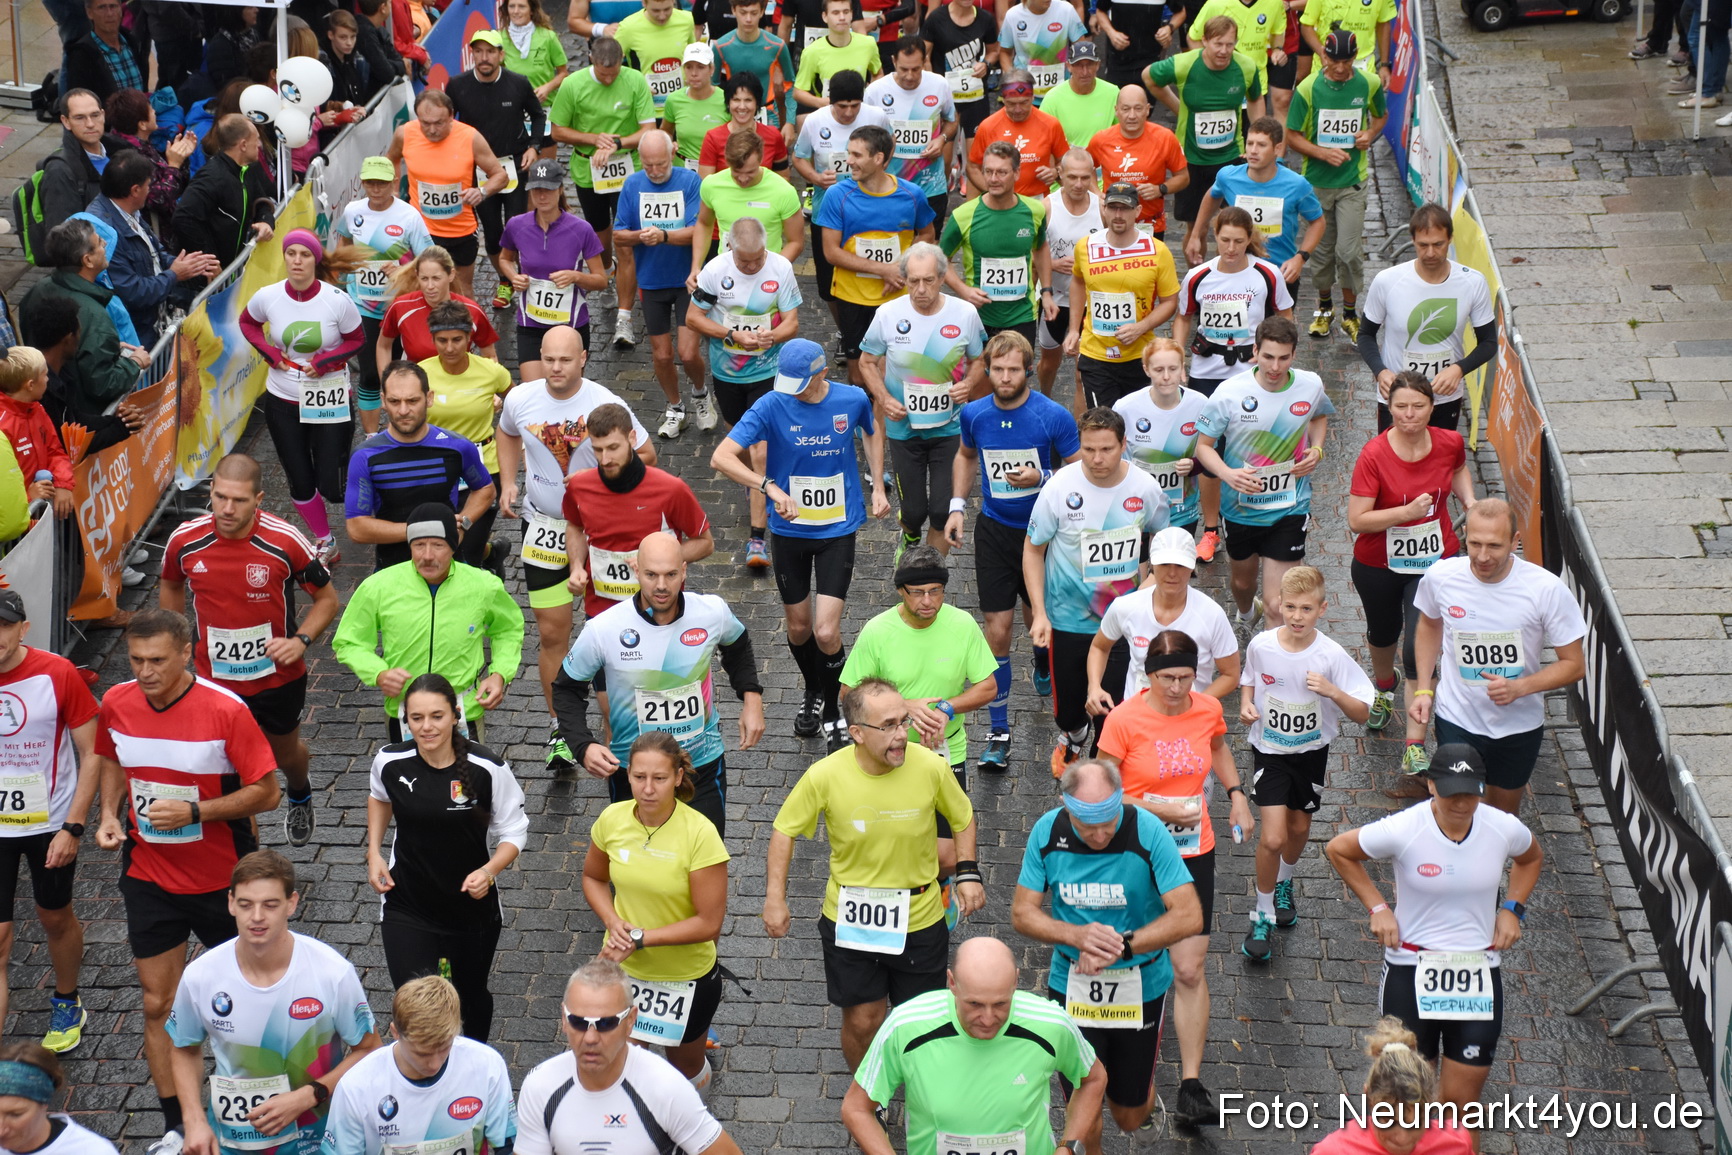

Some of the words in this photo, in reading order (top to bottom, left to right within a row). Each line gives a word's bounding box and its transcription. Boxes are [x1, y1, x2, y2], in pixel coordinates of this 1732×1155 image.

[654, 60, 680, 73] Hervis
[651, 77, 682, 95] 3099
[961, 78, 969, 91] 5
[1035, 73, 1058, 87] 198
[1200, 119, 1233, 135] 2753
[1322, 118, 1358, 134] 2456
[894, 129, 928, 144] 2805
[1206, 135, 1228, 145] Gerhard
[1330, 135, 1348, 144] Albert
[899, 146, 921, 154] Homaid
[601, 162, 627, 179] 205
[422, 191, 459, 207] 2646
[429, 207, 454, 216] Michael
[644, 202, 680, 219] 2471
[1254, 207, 1263, 223] 3
[864, 248, 893, 264] 286
[1089, 264, 1119, 277] MAX
[1123, 259, 1158, 271] BÖGL
[986, 268, 1024, 285] 2317
[535, 290, 564, 309] 167
[992, 288, 1017, 296] Thomas
[535, 309, 558, 320] Kathrin
[1094, 302, 1132, 320] 2813
[1204, 311, 1242, 328] 2221
[305, 387, 344, 407] 2642
[908, 394, 950, 412] 3049
[317, 410, 335, 418] Julia
[790, 425, 803, 433] MIT
[795, 435, 832, 446] JESUS
[802, 488, 836, 507] 600
[1246, 494, 1288, 504] Maximilian
[1088, 538, 1137, 563] 2077
[1393, 533, 1440, 557] 2040
[531, 550, 566, 564] Sebastian
[1403, 559, 1433, 568] Claudia
[606, 563, 630, 581] 48
[1103, 565, 1125, 575] David
[603, 584, 636, 594] Matthias
[683, 633, 707, 643] Hervis
[215, 637, 267, 661] 2425
[1462, 644, 1518, 666] 3089
[228, 663, 258, 675] Jochen
[644, 695, 699, 722] 2120
[1268, 708, 1317, 733] 3093
[23, 740, 47, 750] HERZ
[1159, 756, 1205, 780] FAST
[1059, 882, 1126, 899] HUBER
[845, 899, 900, 929] 3001
[1424, 967, 1484, 993] 3091
[1089, 980, 1119, 1004] 87
[292, 1002, 320, 1014] Hervis
[1072, 1005, 1137, 1020] Hans-Werner
[1420, 996, 1495, 1013] STEPHANIE
[211, 1019, 234, 1028] PARTL
[241, 1079, 280, 1090] BOCK
[453, 1102, 479, 1115] Hervis
[977, 1135, 1018, 1147] BOCK
